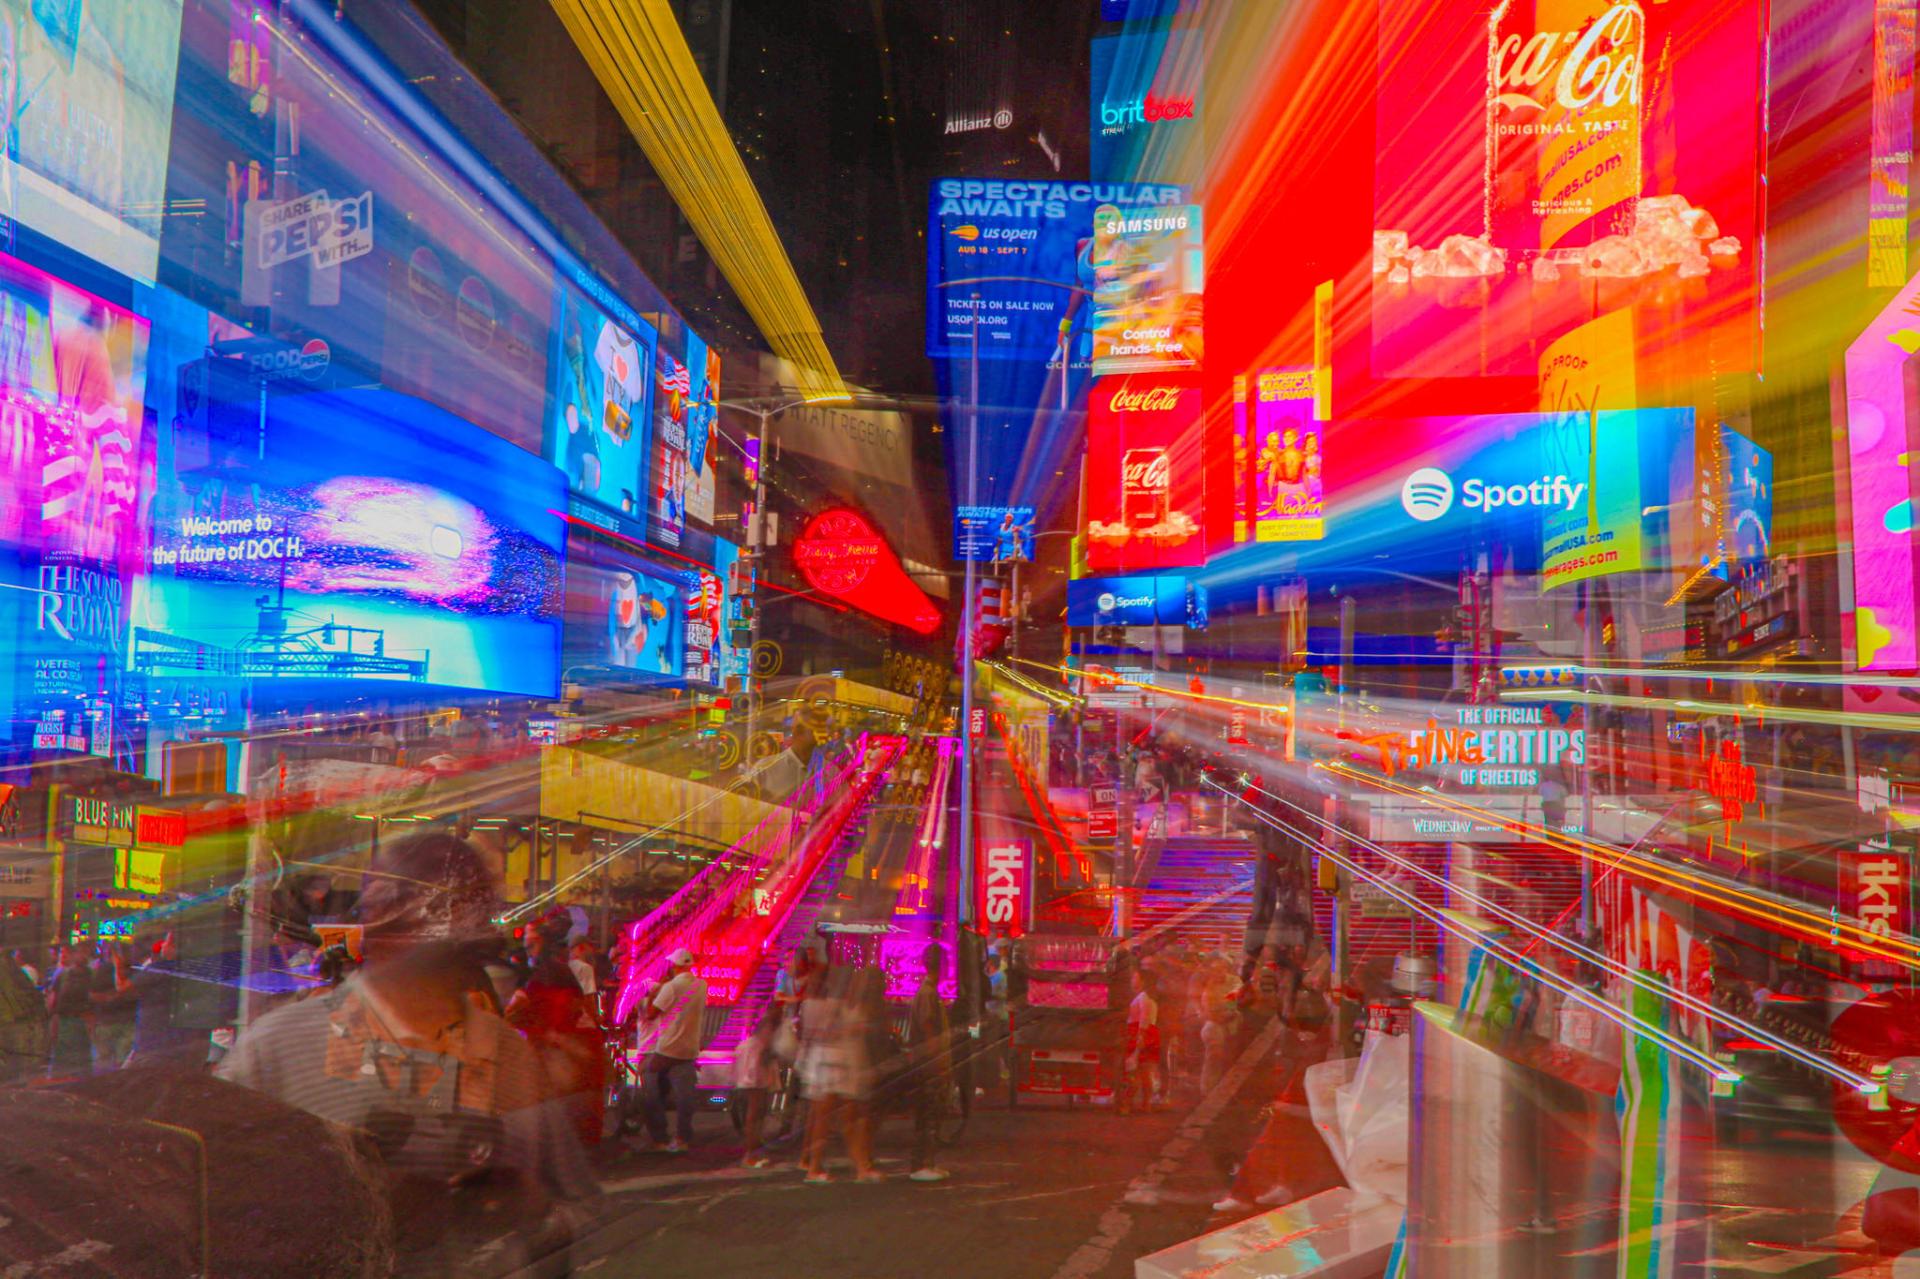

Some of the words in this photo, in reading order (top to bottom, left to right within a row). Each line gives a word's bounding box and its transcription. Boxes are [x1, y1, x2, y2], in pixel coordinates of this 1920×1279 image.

[944, 117, 992, 135] Allianz
[1499, 121, 1576, 136] ORIGINAL
[1583, 119, 1629, 133] TASTE
[939, 181, 1182, 205] SPECTACULAR
[263, 200, 312, 227] SHARE
[938, 199, 1067, 219] AWAITS
[261, 199, 370, 264] PEPSI
[983, 228, 999, 239] us
[1001, 228, 1038, 242] open
[1106, 217, 1188, 235] SAMSUNG
[958, 246, 976, 254] AUG
[997, 246, 1019, 254] SEPT
[947, 299, 987, 310] TICKETS
[989, 300, 1003, 310] ON
[1006, 301, 1030, 311] SALE
[1032, 302, 1055, 311] NOW
[1123, 328, 1171, 341] Control
[1110, 342, 1183, 356] hands-free
[1110, 387, 1181, 412] Coca-Cola
[1462, 475, 1584, 512] Spotify
[181, 517, 251, 536] Welcome
[255, 514, 272, 531] to
[153, 546, 177, 564] the
[180, 543, 224, 563] future
[228, 541, 245, 560] of
[247, 539, 284, 559] DOC
[287, 537, 303, 558] H.
[1116, 596, 1155, 609] Spotify
[1457, 708, 1481, 724] THE
[1485, 708, 1543, 724] OFFICIAL
[1461, 770, 1477, 785] OF
[1480, 769, 1538, 786] CHEETOS
[75, 798, 109, 826] BLUE
[1413, 818, 1472, 833] WEDNESDAY
[986, 845, 1023, 923] tkts
[1857, 858, 1900, 945] tkts
